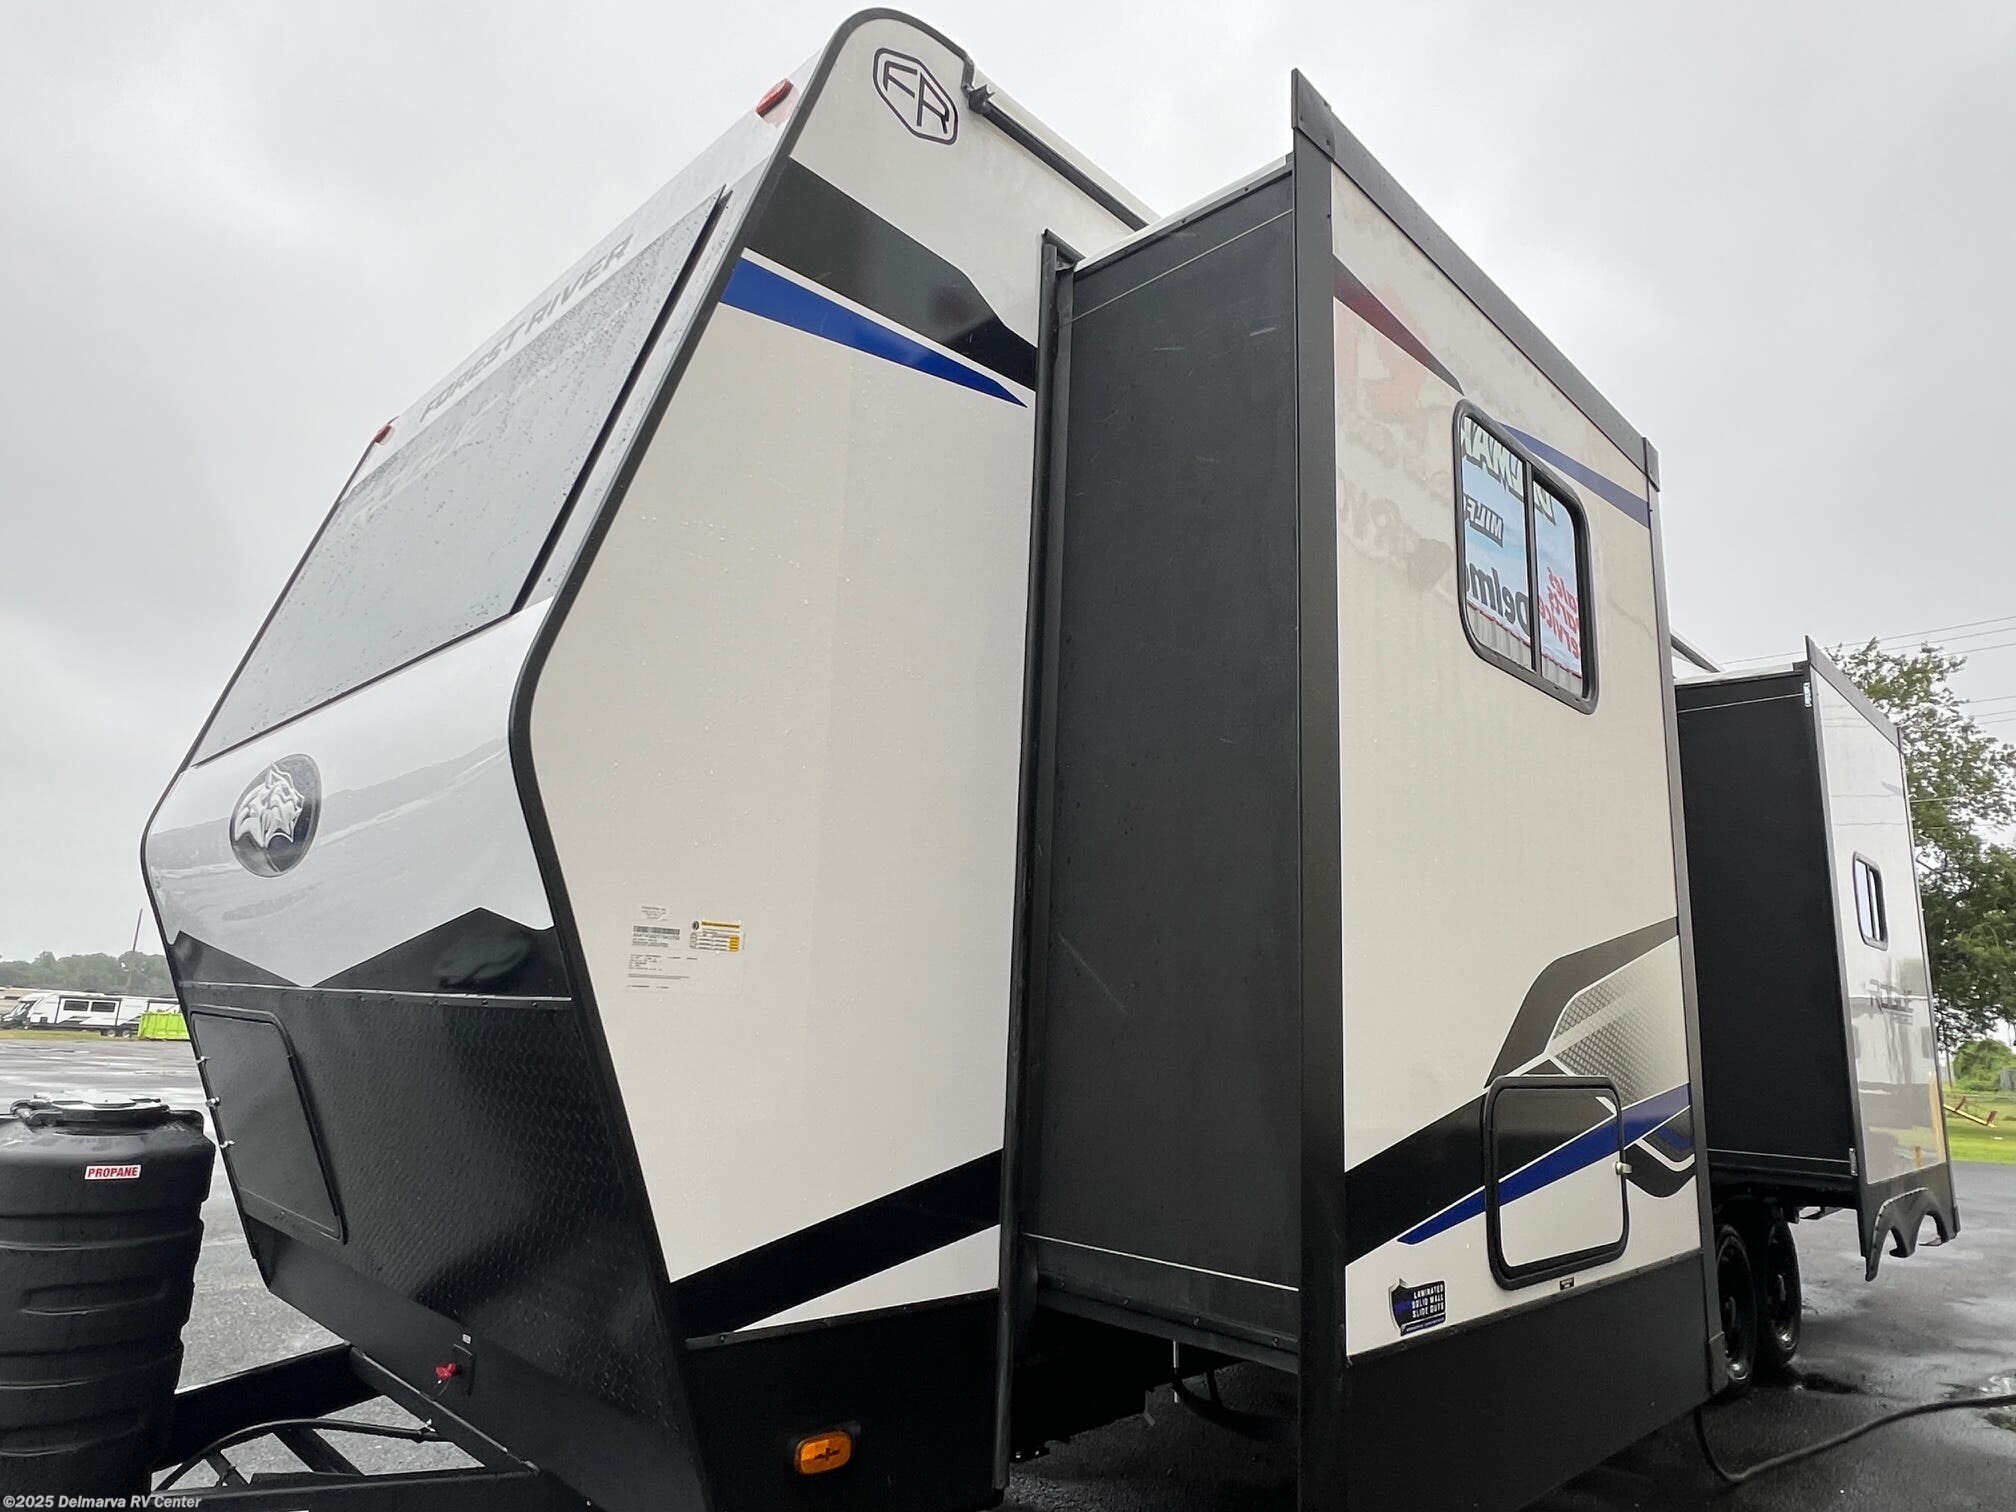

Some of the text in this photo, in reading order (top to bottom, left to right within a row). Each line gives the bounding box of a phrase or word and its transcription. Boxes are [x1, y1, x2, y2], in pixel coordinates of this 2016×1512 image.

[883, 60, 950, 135] FR
[419, 233, 634, 423] FOREST RIVER
[88, 1167, 138, 1178] PROPANE
[1412, 1293, 1444, 1309] SOLID WALL
[1412, 1302, 1443, 1318] SLIDE OUTS
